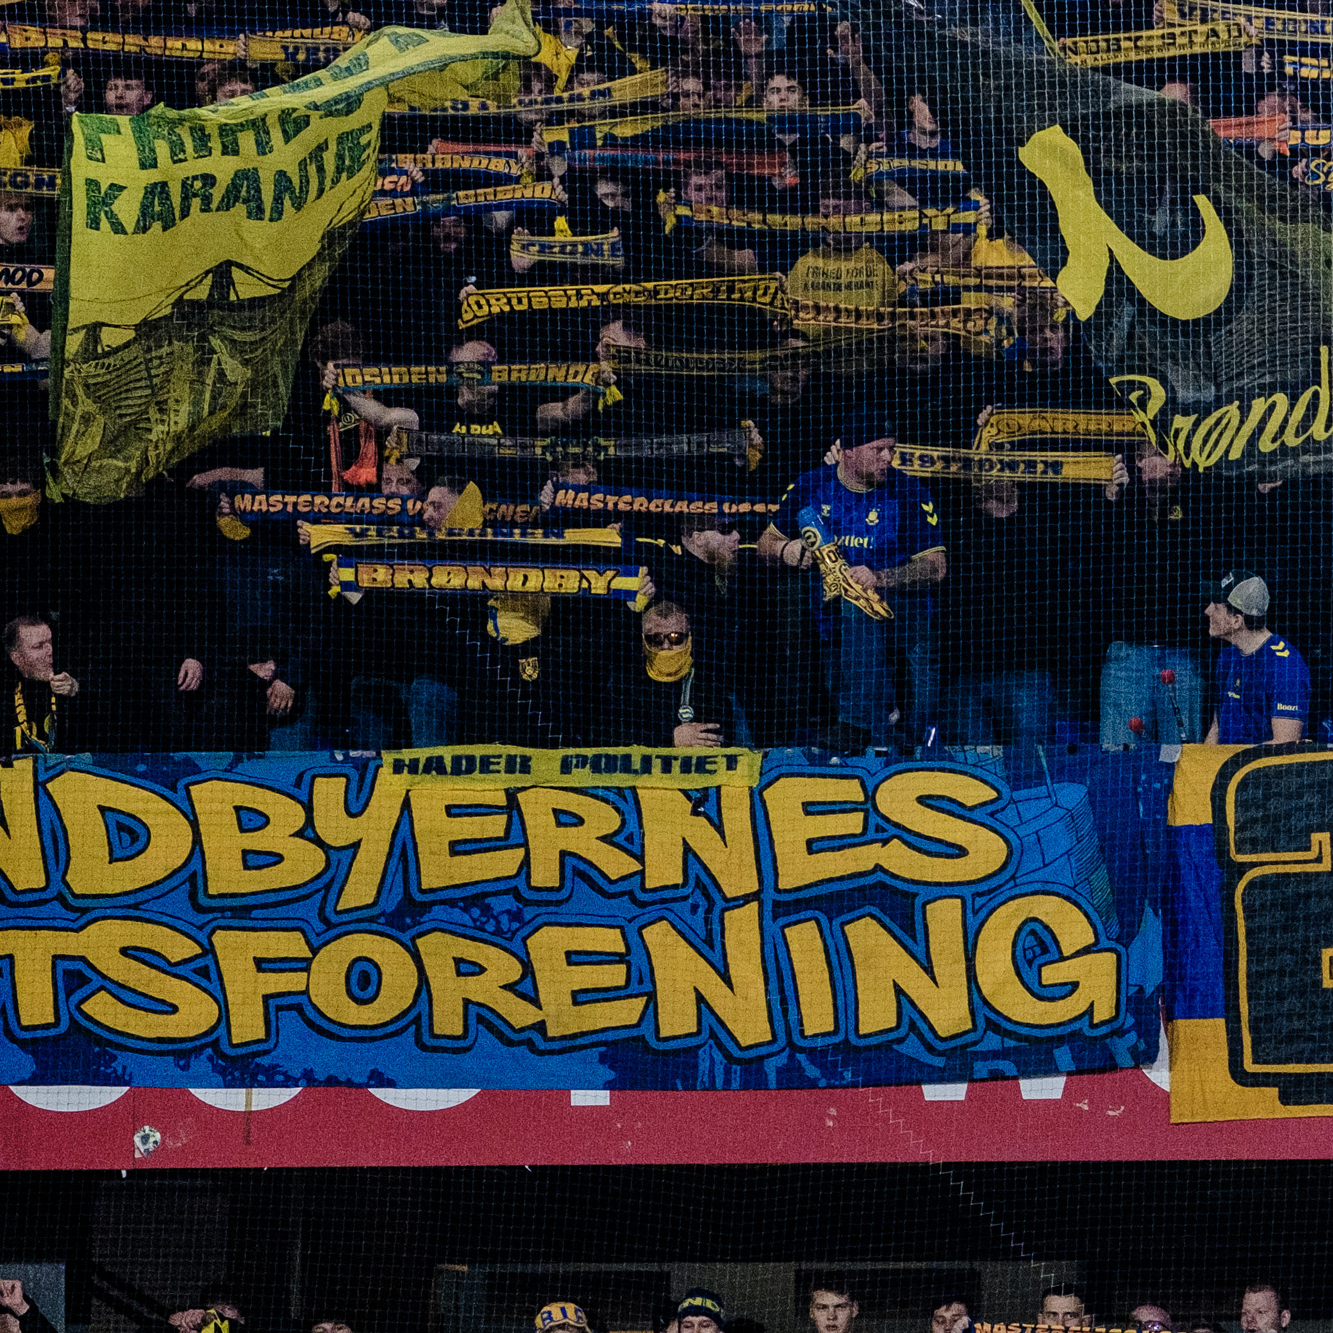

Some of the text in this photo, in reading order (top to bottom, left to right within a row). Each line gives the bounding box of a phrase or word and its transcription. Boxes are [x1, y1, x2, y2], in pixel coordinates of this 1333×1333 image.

[337, 364, 448, 387] DSIDEN
[233, 491, 403, 518] MASTERCLASS
[555, 489, 719, 516] MASTERCLASS
[356, 562, 619, 595] BRØNDBY
[393, 753, 741, 778] HADER POLITIET
